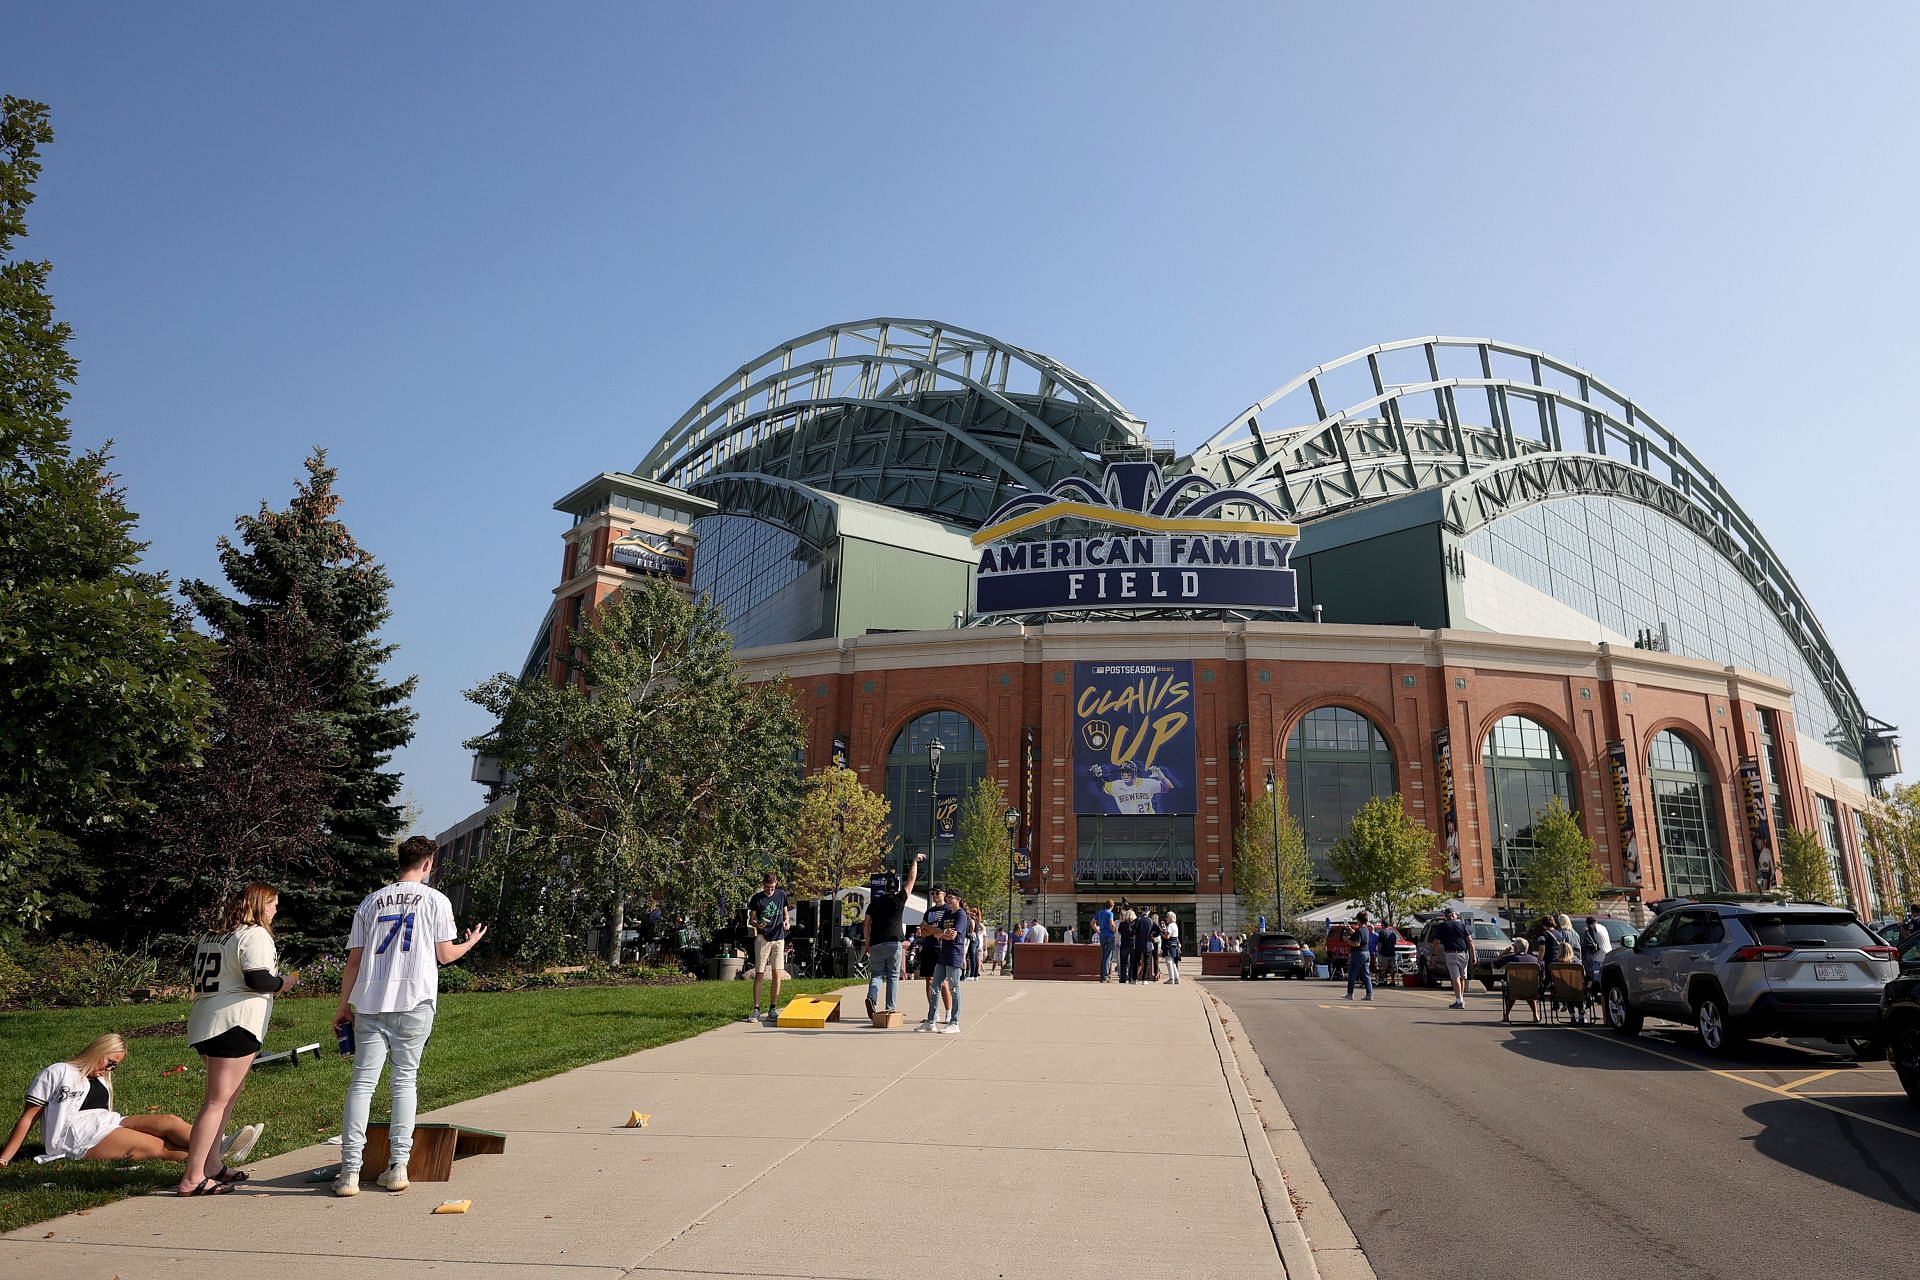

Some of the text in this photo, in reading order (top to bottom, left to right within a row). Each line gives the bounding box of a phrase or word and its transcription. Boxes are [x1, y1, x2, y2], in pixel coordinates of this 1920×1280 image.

[636, 558, 667, 571] FIELD
[976, 537, 1293, 574] AMERICAN FAMILY
[1068, 571, 1199, 600] FIELD
[1105, 665, 1156, 674] POSTSEASON
[1077, 674, 1190, 718] CLAWS
[1110, 711, 1189, 772] UP
[1746, 769, 1763, 793] OF
[1138, 801, 1151, 813] 27
[1621, 783, 1632, 807] 53
[936, 803, 958, 820] UP
[1752, 797, 1767, 821] 22
[1072, 860, 1197, 875] BREWERS TEAM STORE
[376, 893, 422, 910] HADER
[375, 912, 416, 954] 71
